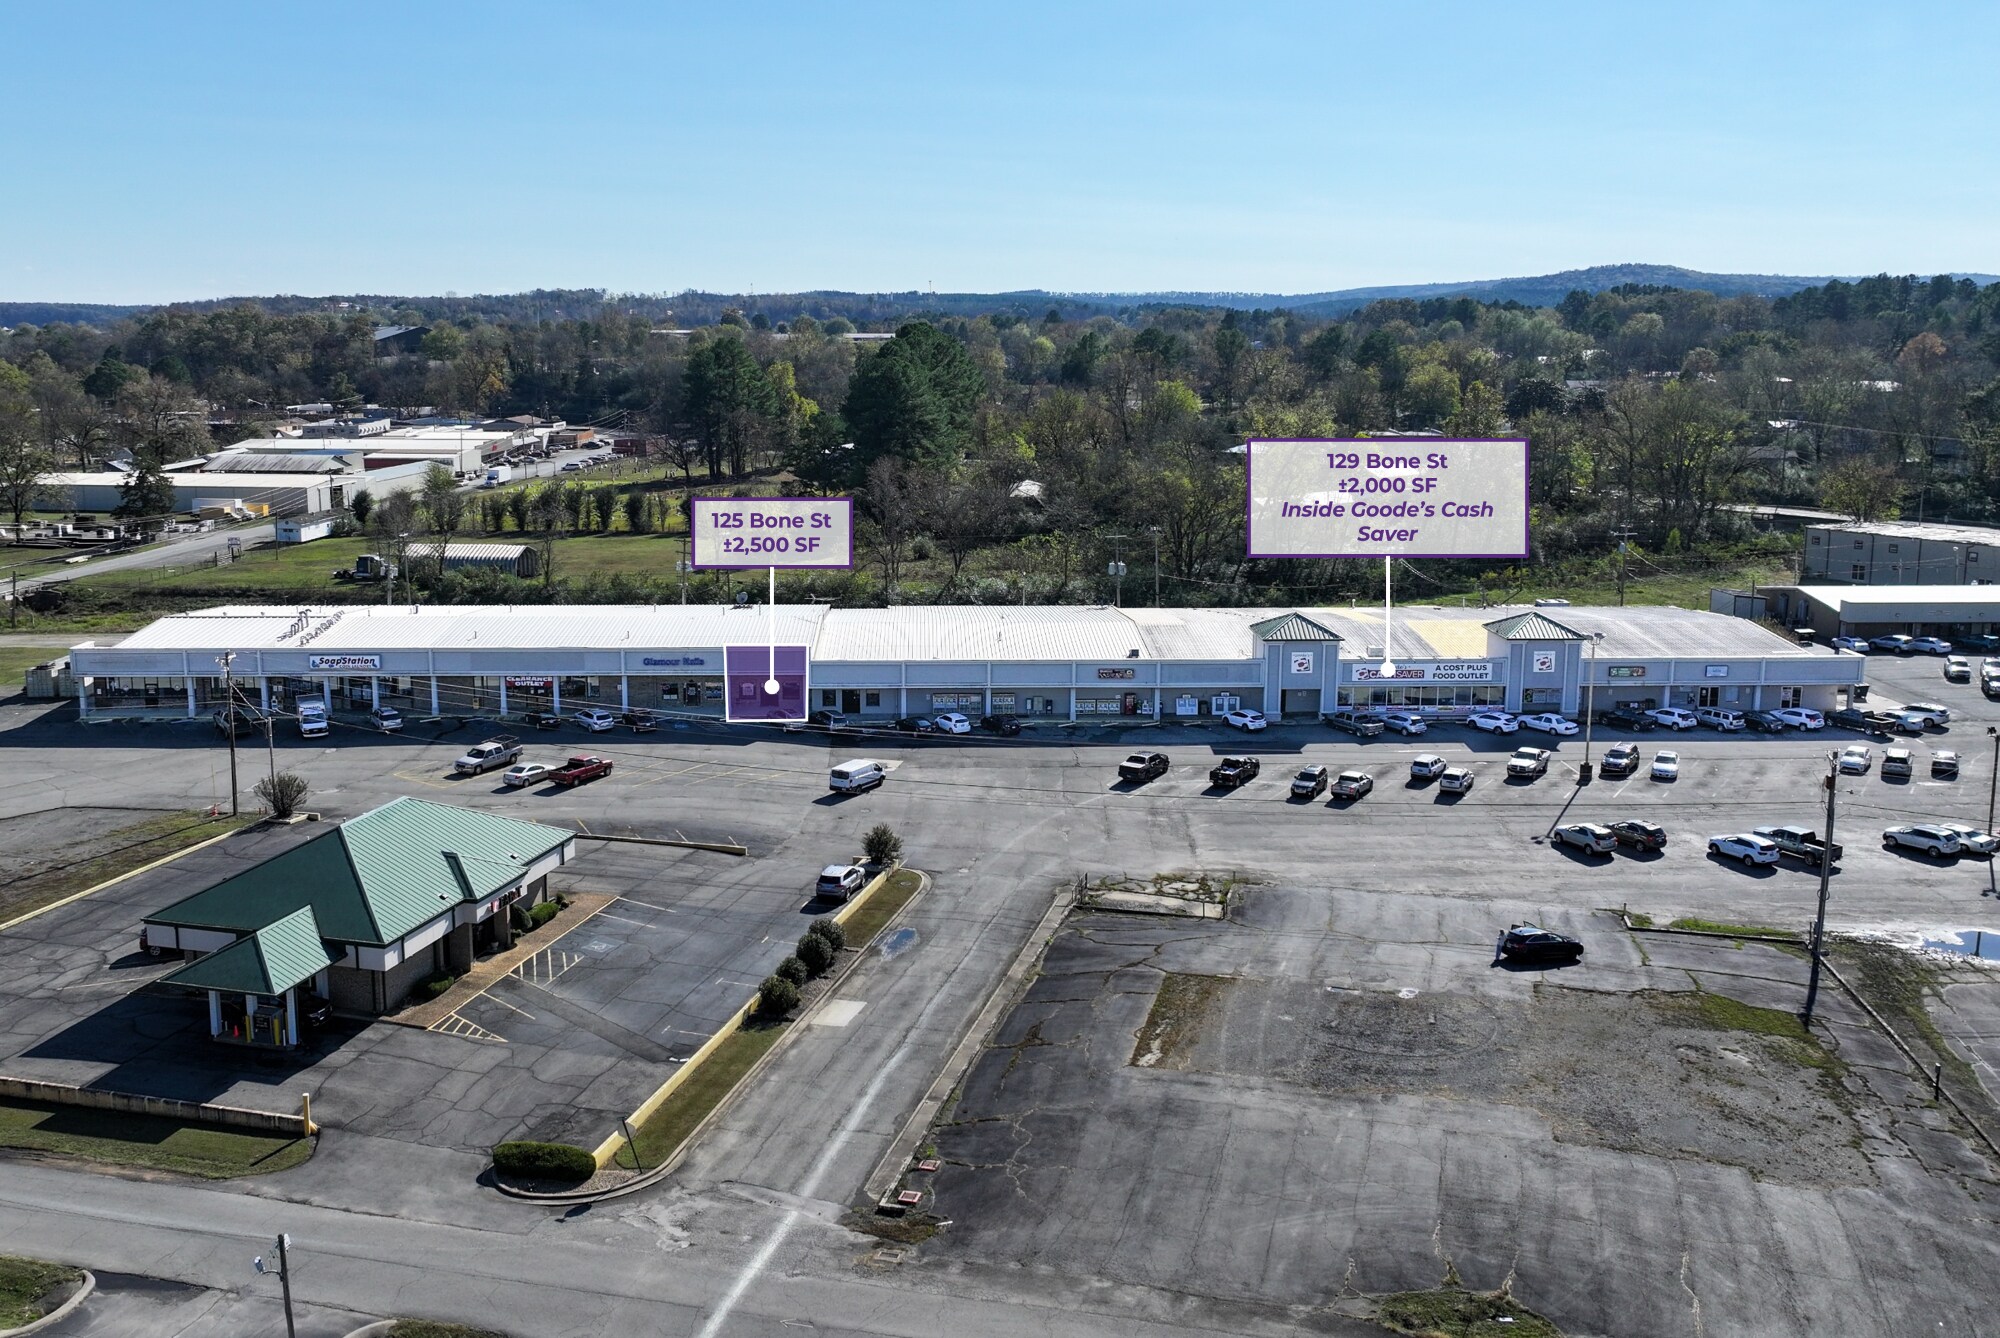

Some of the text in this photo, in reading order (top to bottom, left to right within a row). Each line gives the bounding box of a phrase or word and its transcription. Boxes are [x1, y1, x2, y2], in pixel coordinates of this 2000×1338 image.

[643, 657, 681, 666] Glamour
[1432, 672, 1489, 680] FOOD OUTLET
